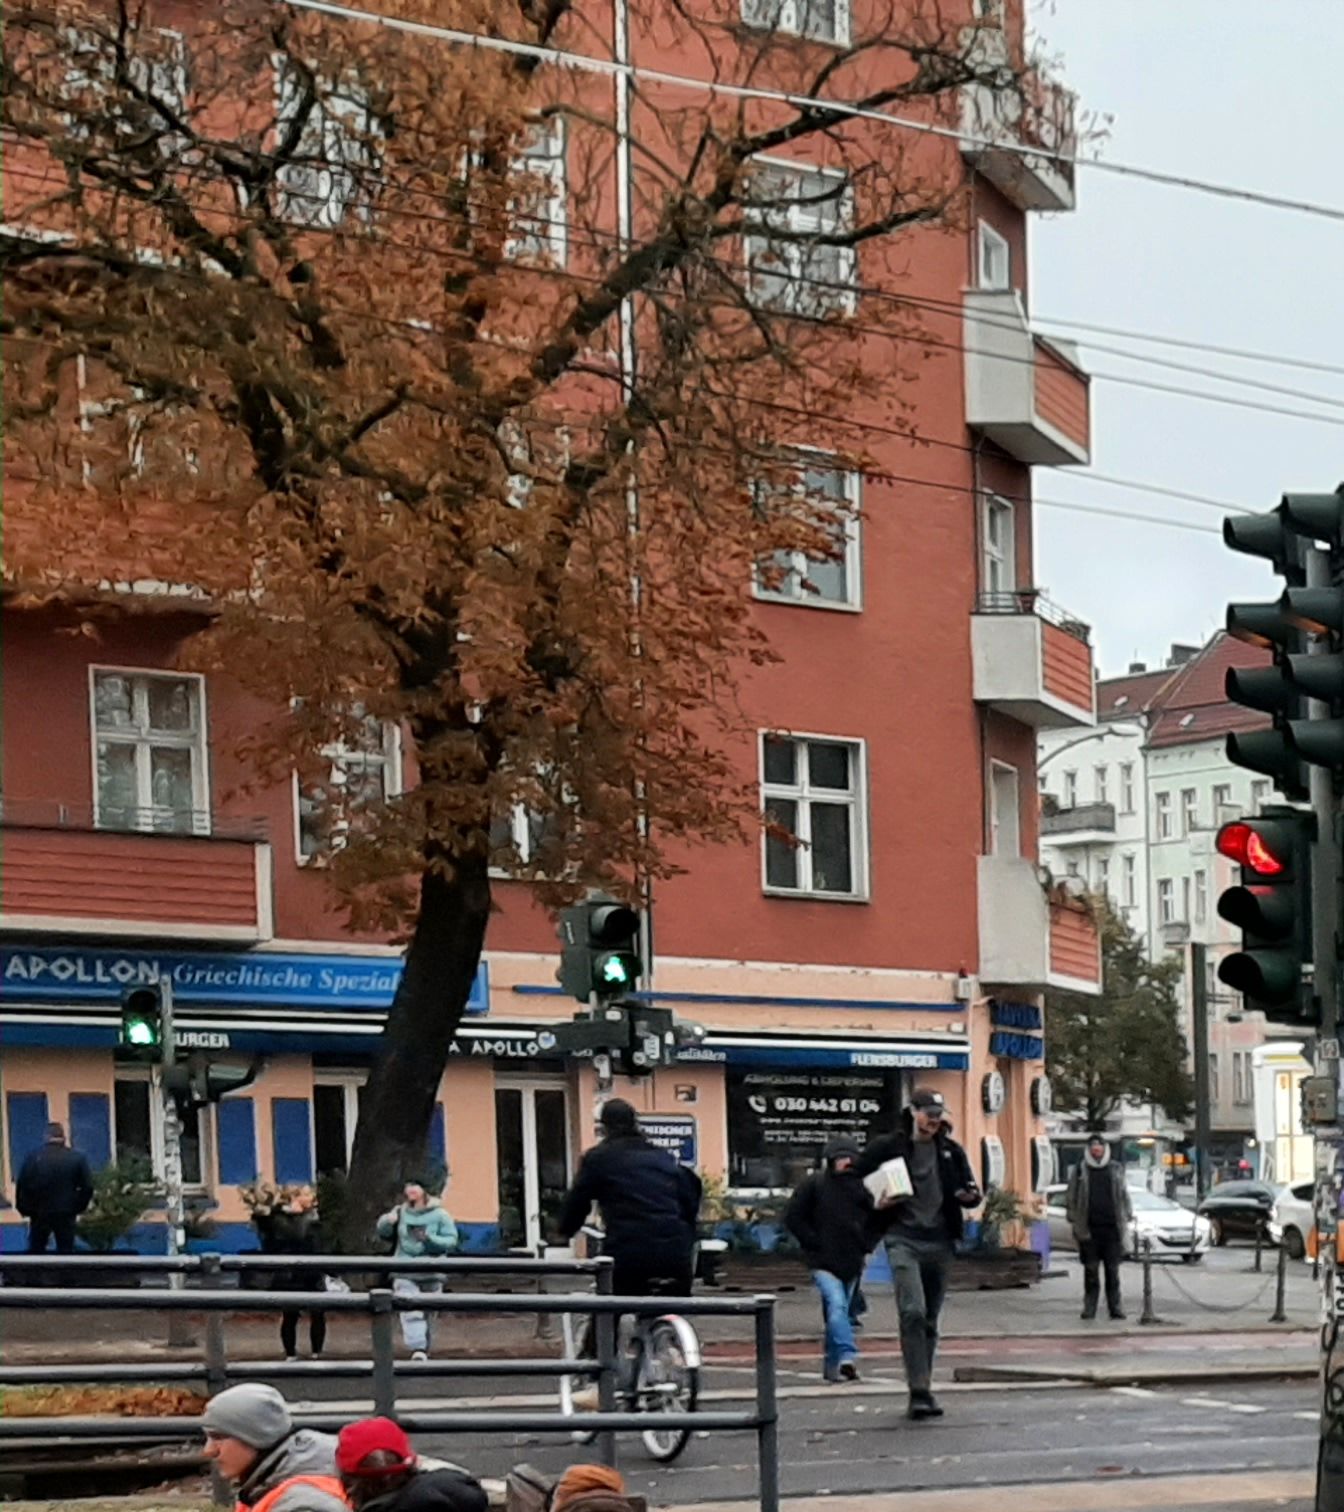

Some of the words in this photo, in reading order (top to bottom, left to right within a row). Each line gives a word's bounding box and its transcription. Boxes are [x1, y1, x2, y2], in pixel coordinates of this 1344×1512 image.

[5, 954, 160, 985] APOLLON
[173, 962, 311, 988] Griechische
[318, 967, 398, 994] Spezial
[471, 1040, 540, 1057] APOLLO
